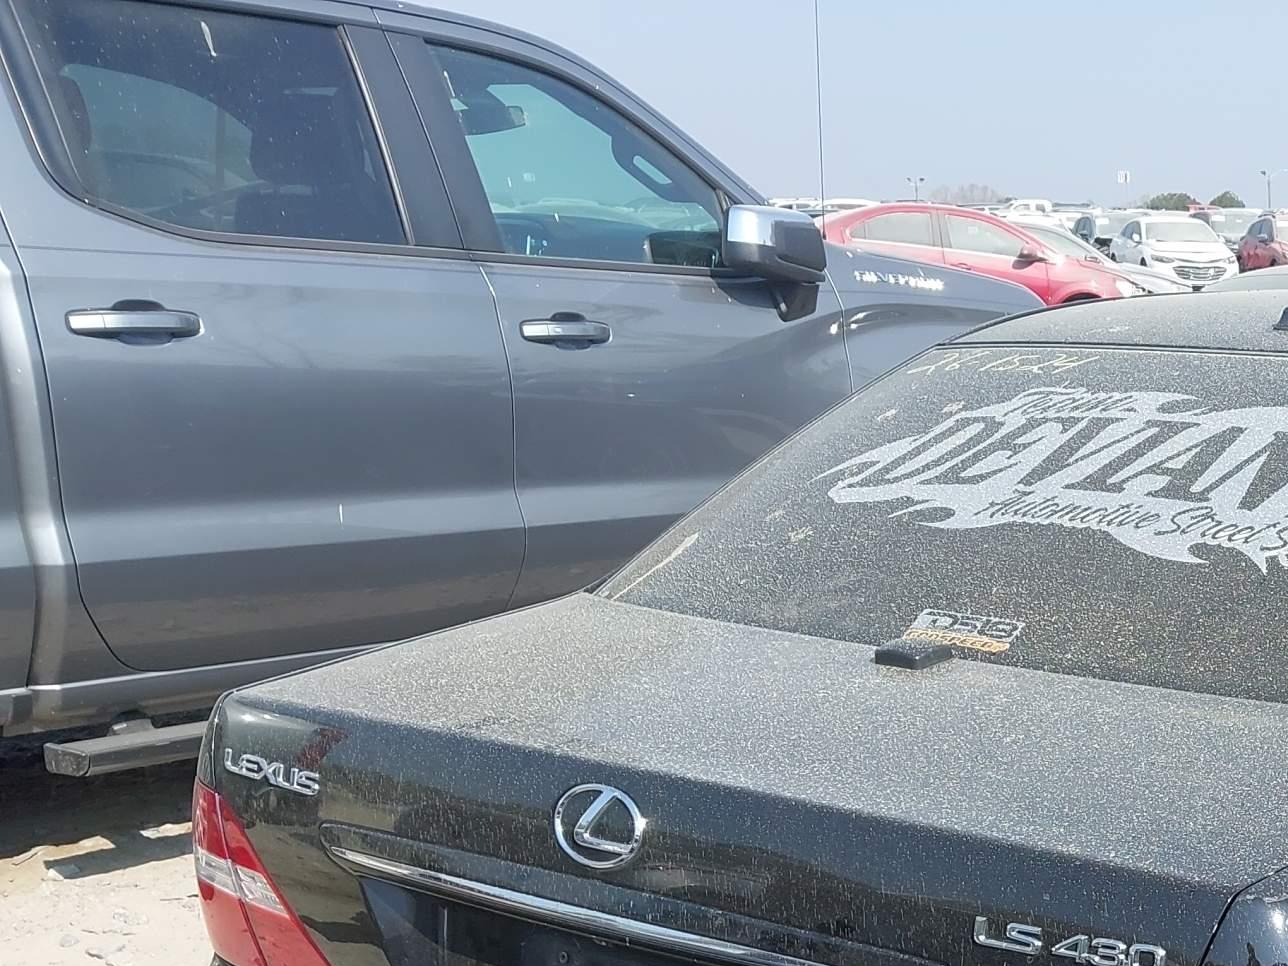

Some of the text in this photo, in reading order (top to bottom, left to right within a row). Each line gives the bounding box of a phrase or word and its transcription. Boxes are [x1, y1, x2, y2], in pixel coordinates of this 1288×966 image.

[906, 350, 1101, 376] 26-1524
[974, 490, 1161, 530] Automotive
[1154, 504, 1279, 545] Street
[223, 747, 320, 796] LEXUS
[973, 915, 1042, 955] LS
